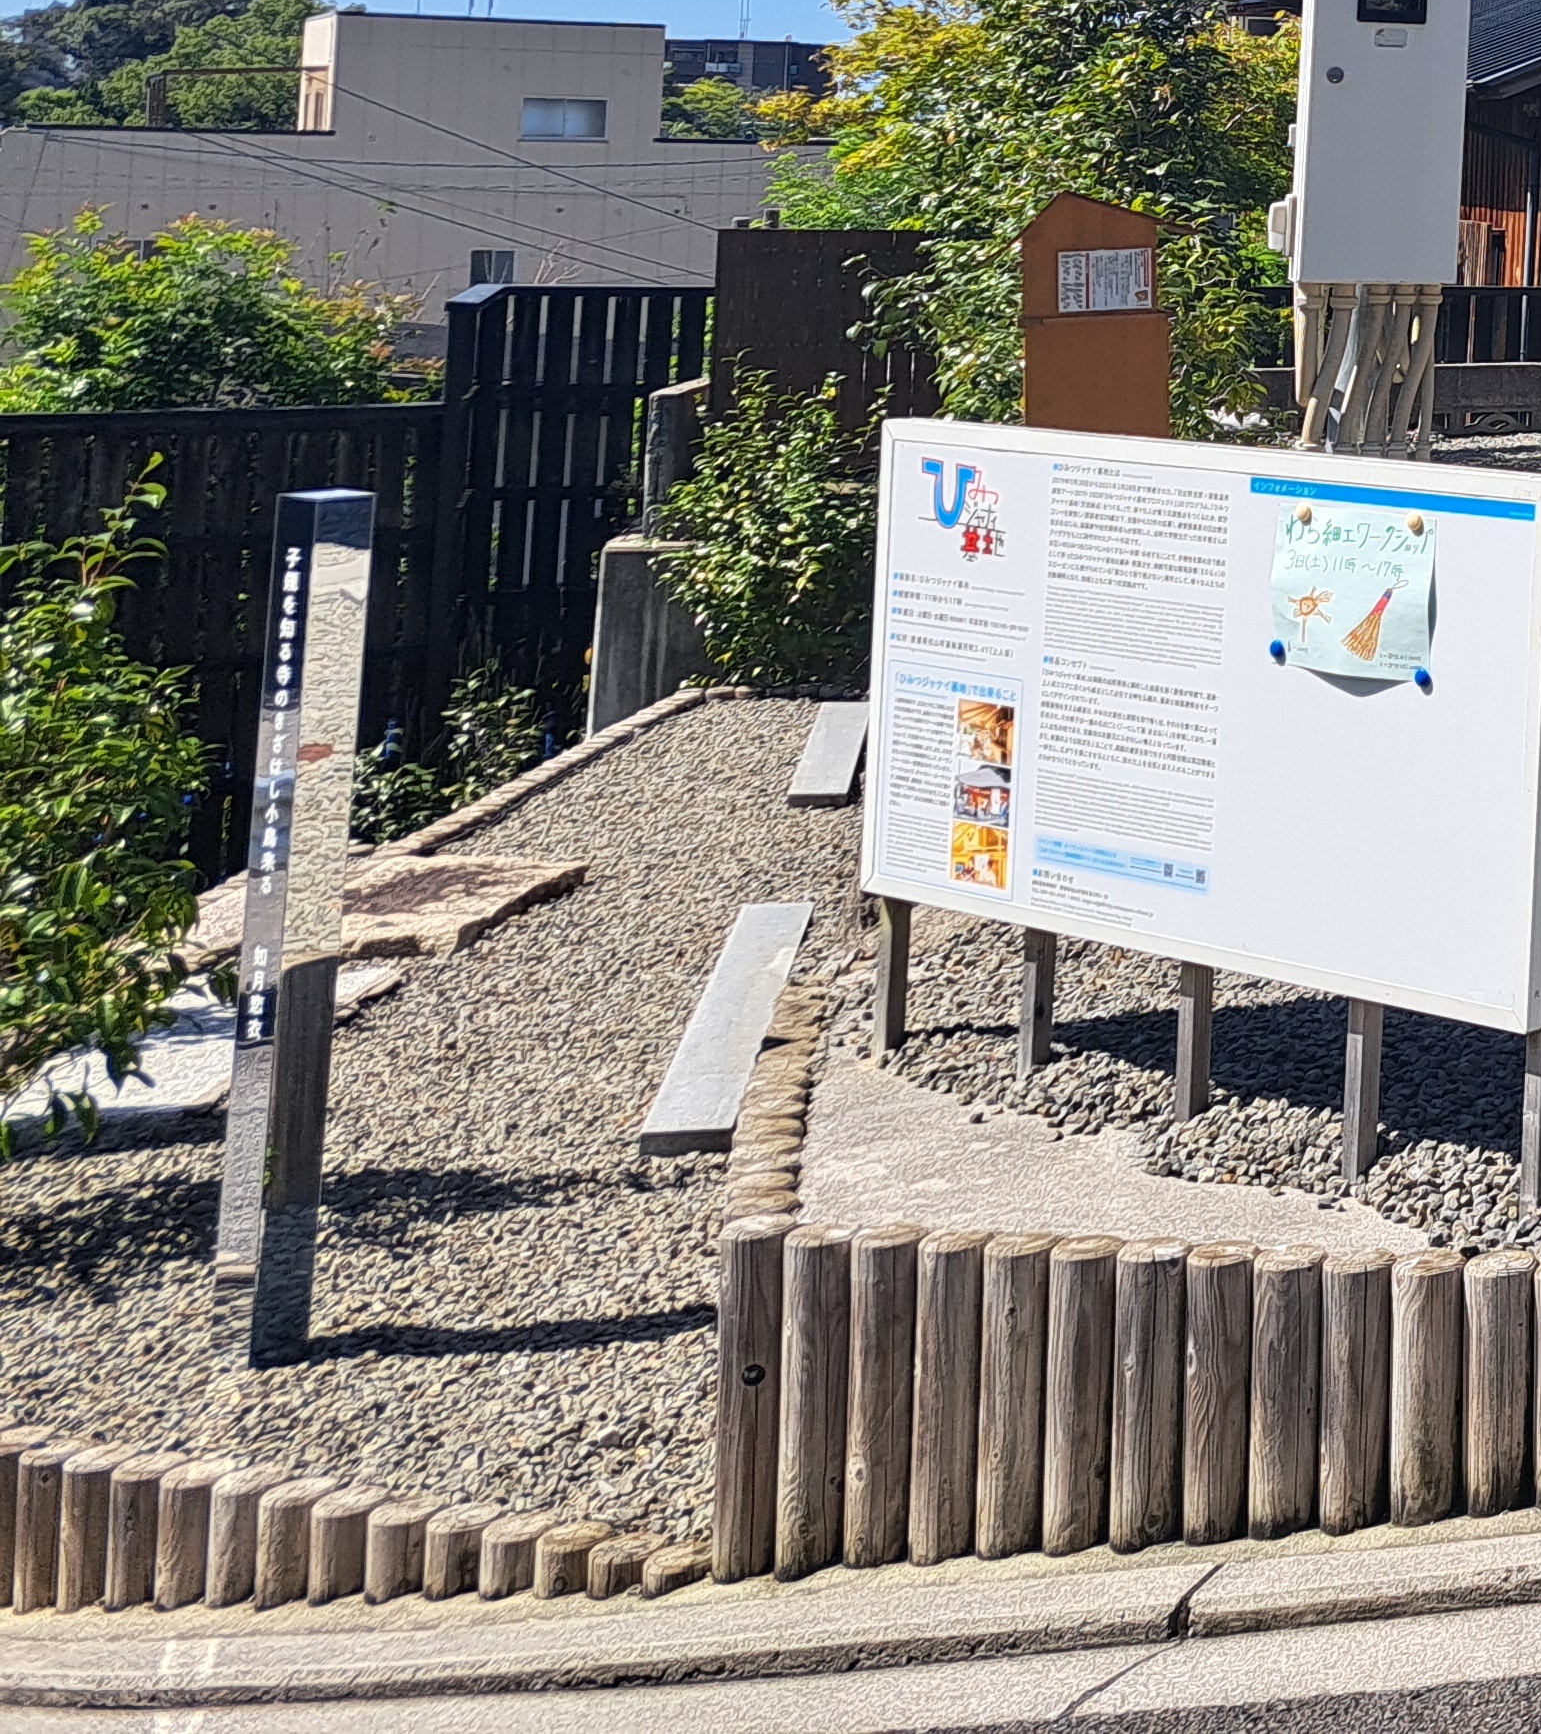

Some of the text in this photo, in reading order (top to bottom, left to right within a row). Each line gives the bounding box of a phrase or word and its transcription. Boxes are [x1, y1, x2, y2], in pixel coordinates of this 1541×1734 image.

[1253, 480, 1318, 497] インフォメーション
